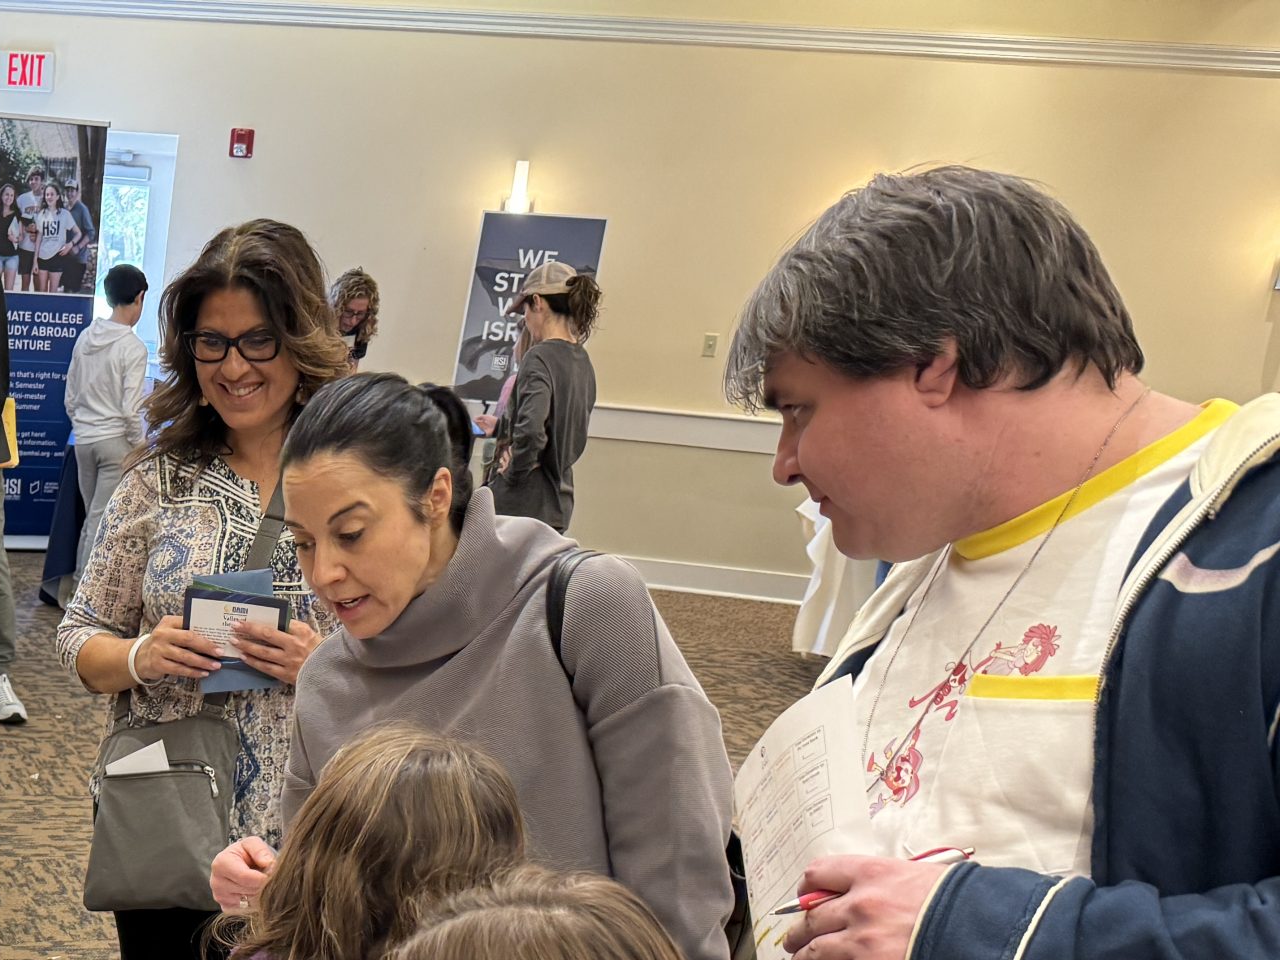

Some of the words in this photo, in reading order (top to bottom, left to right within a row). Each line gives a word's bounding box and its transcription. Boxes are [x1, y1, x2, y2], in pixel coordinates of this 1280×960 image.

[8, 54, 45, 87] EXIT
[42, 220, 60, 236] HSI
[518, 249, 558, 270] WE
[35, 312, 83, 324] COLLEGE
[8, 324, 29, 335] UDY
[31, 326, 76, 338] ABROAD
[8, 339, 51, 350] ENTURE
